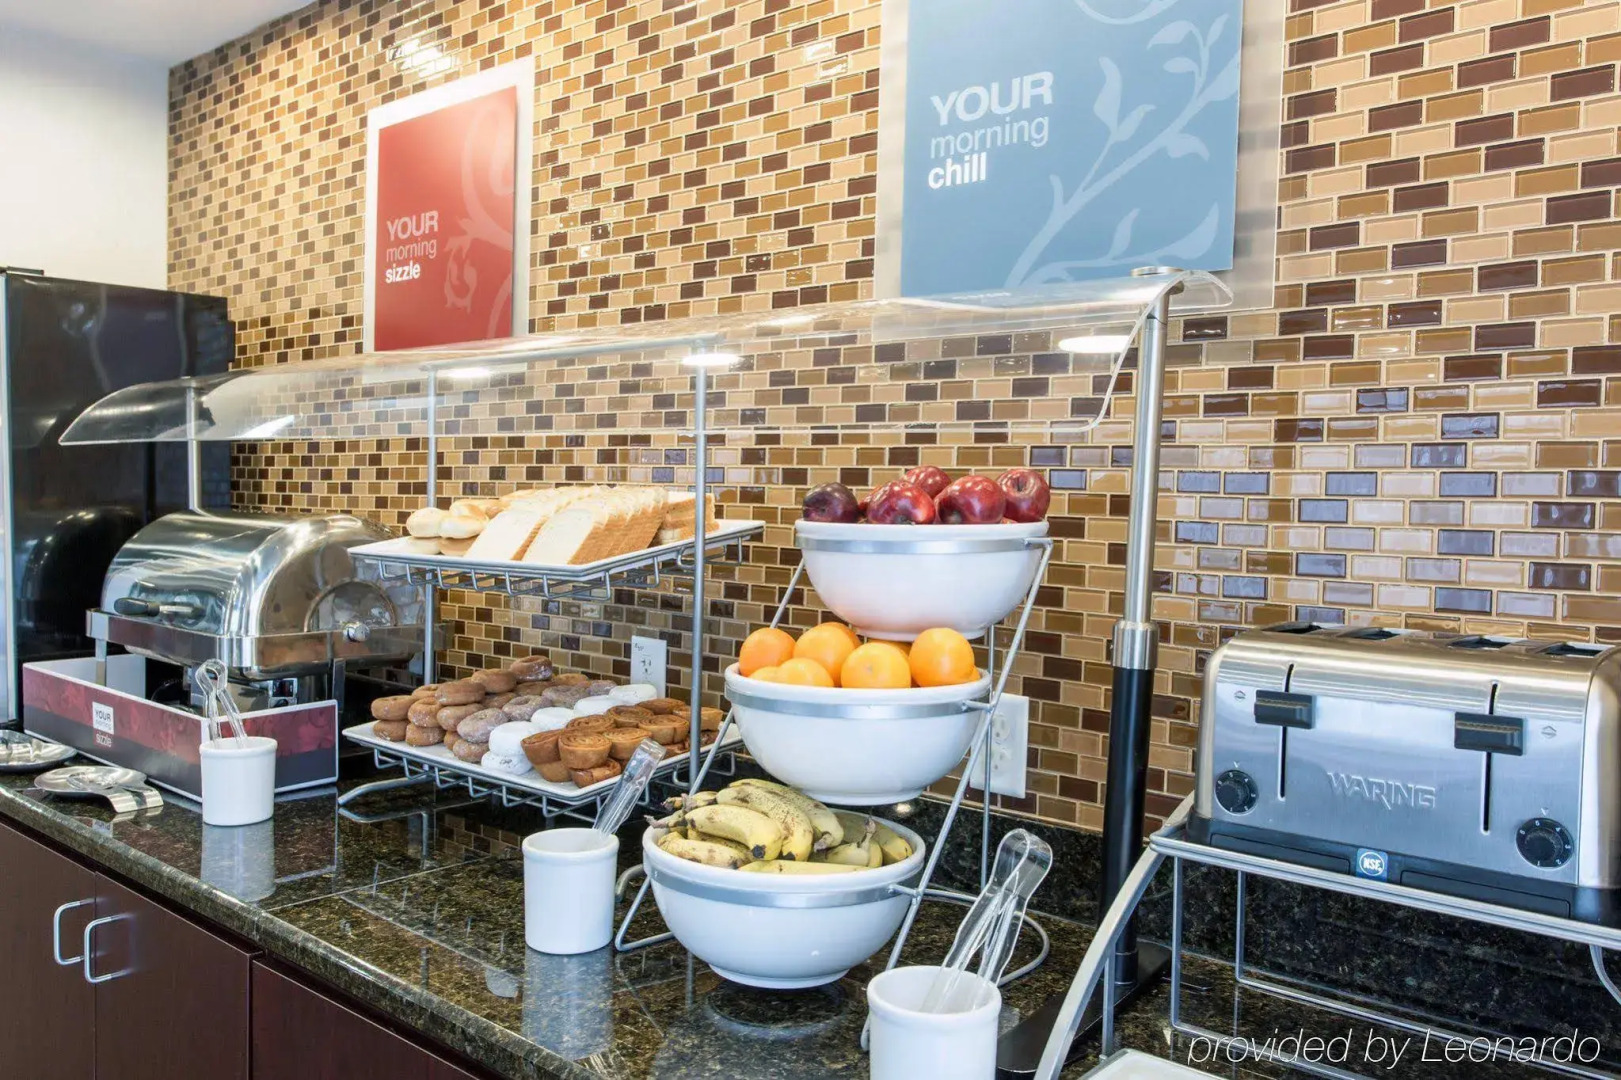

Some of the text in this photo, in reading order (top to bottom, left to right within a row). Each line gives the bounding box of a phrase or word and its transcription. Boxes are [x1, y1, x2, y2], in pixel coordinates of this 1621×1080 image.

[930, 71, 1054, 126] YOUR
[930, 116, 1049, 159] morning
[928, 152, 987, 189] chill
[386, 210, 439, 241] YOUR
[386, 238, 437, 262] morning
[385, 260, 421, 284] sizzle
[95, 710, 111, 721] YOUR
[1326, 772, 1436, 811] WARING
[1362, 857, 1382, 873] NSF
